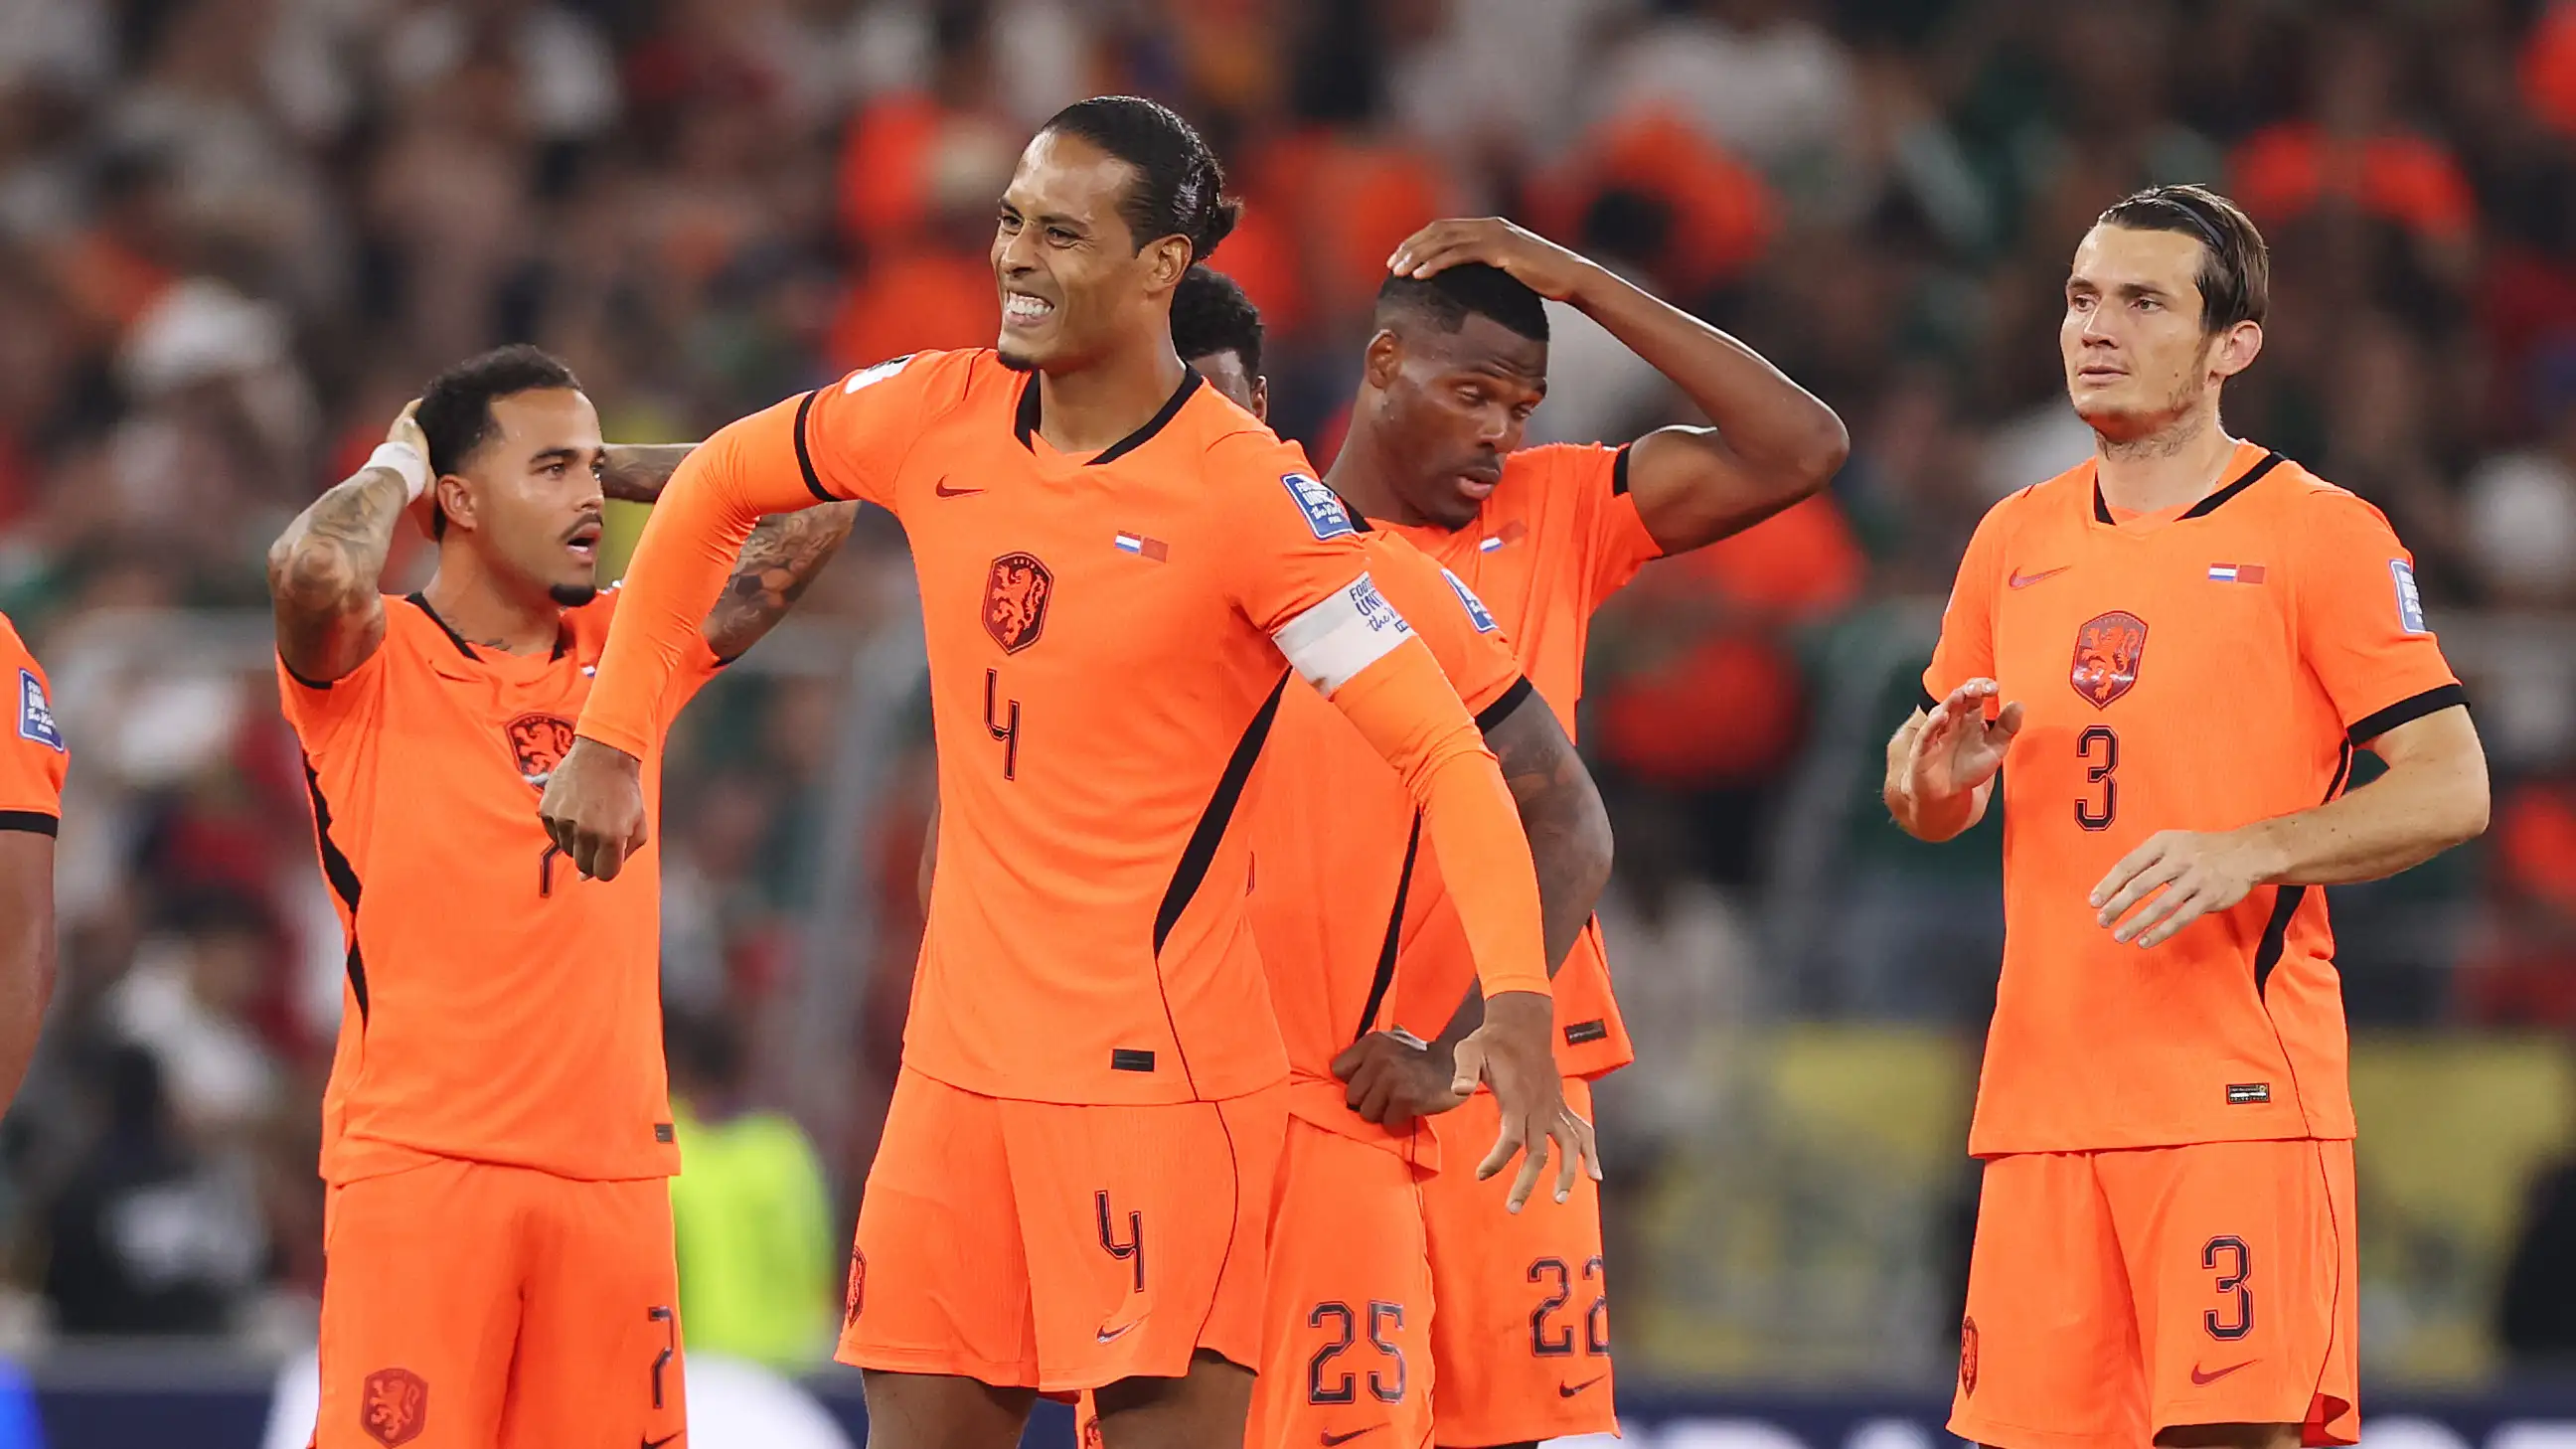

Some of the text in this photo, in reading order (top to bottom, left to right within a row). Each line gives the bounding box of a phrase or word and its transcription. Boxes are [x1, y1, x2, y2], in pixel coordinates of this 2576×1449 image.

[984, 668, 1020, 781] 4
[2074, 725, 2119, 832] 3
[1094, 1190, 1144, 1293] 4
[2201, 1234, 2254, 1341] 3
[1308, 1299, 1406, 1405] 25
[1528, 1255, 1610, 1357] 22
